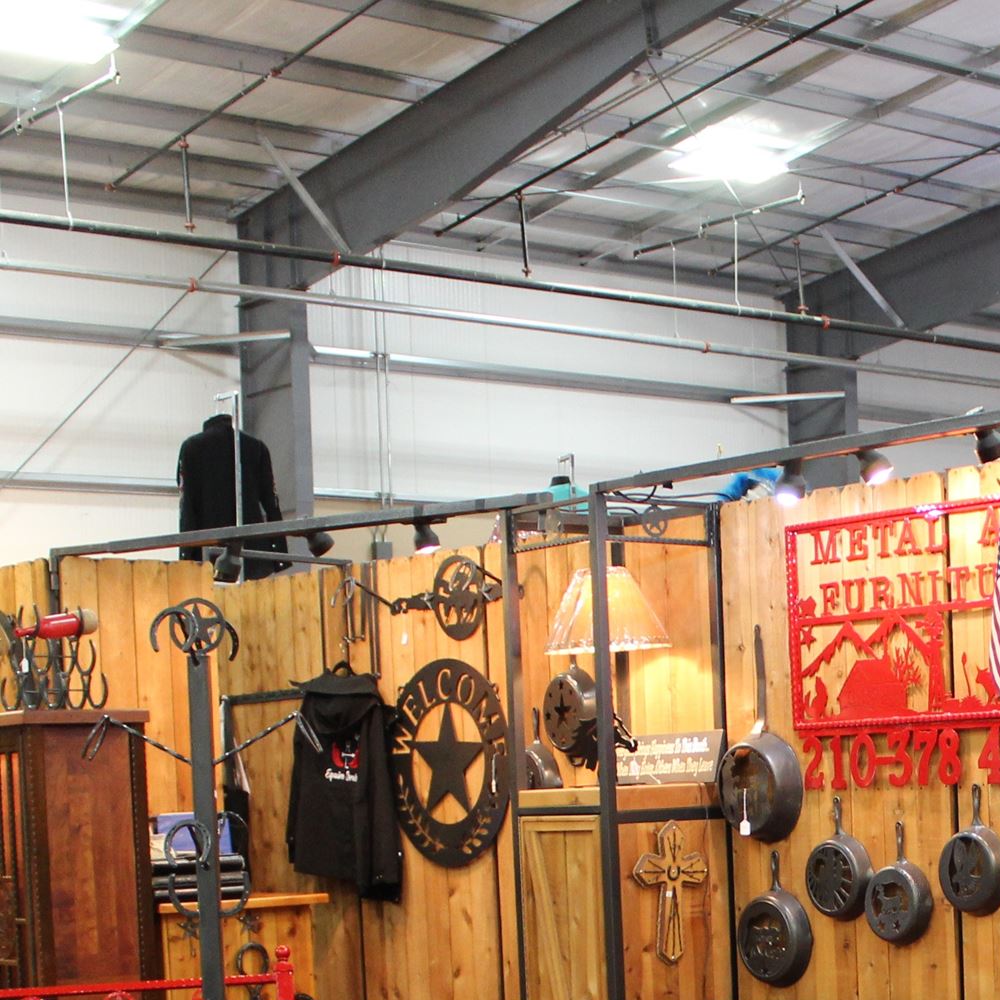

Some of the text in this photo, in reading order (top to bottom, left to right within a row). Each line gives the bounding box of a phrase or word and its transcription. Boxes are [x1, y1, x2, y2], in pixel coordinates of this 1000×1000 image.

[810, 515, 948, 565] METAL
[392, 668, 508, 756] WELCOME
[803, 727, 961, 791] 210-378
